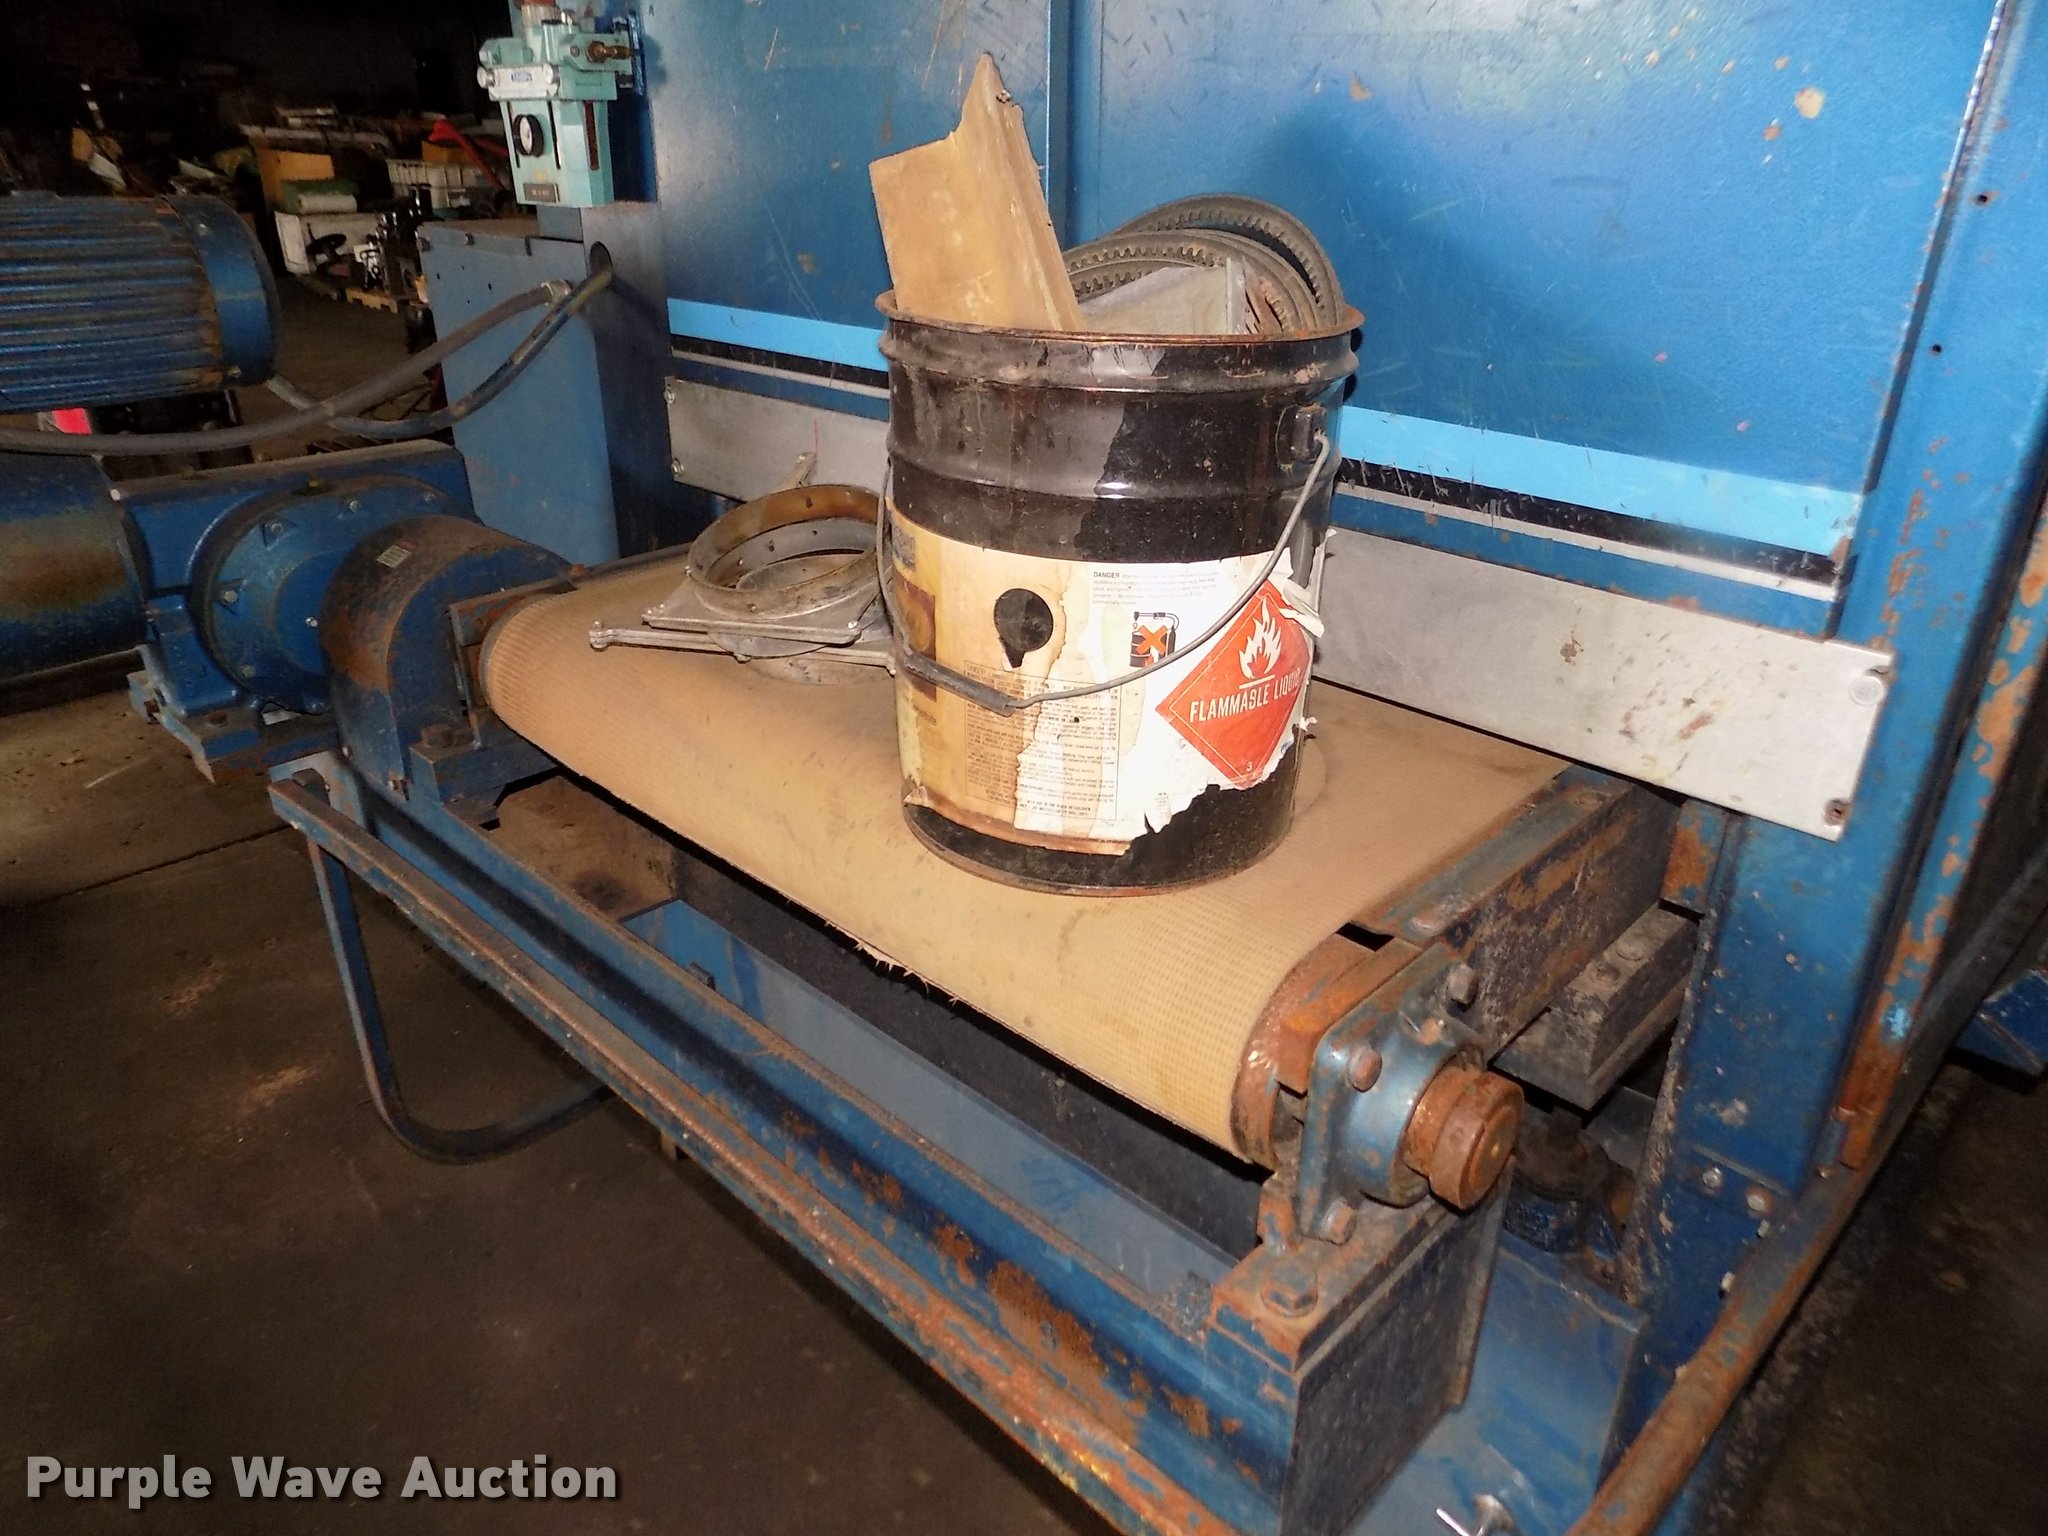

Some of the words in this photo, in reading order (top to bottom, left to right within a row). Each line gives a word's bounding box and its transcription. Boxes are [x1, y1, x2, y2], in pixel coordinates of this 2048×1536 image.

[1093, 571, 1120, 579] DANGER
[1189, 684, 1270, 722] FLAMMABLE
[1273, 667, 1301, 699] LIQUID
[1245, 760, 1253, 772] 3
